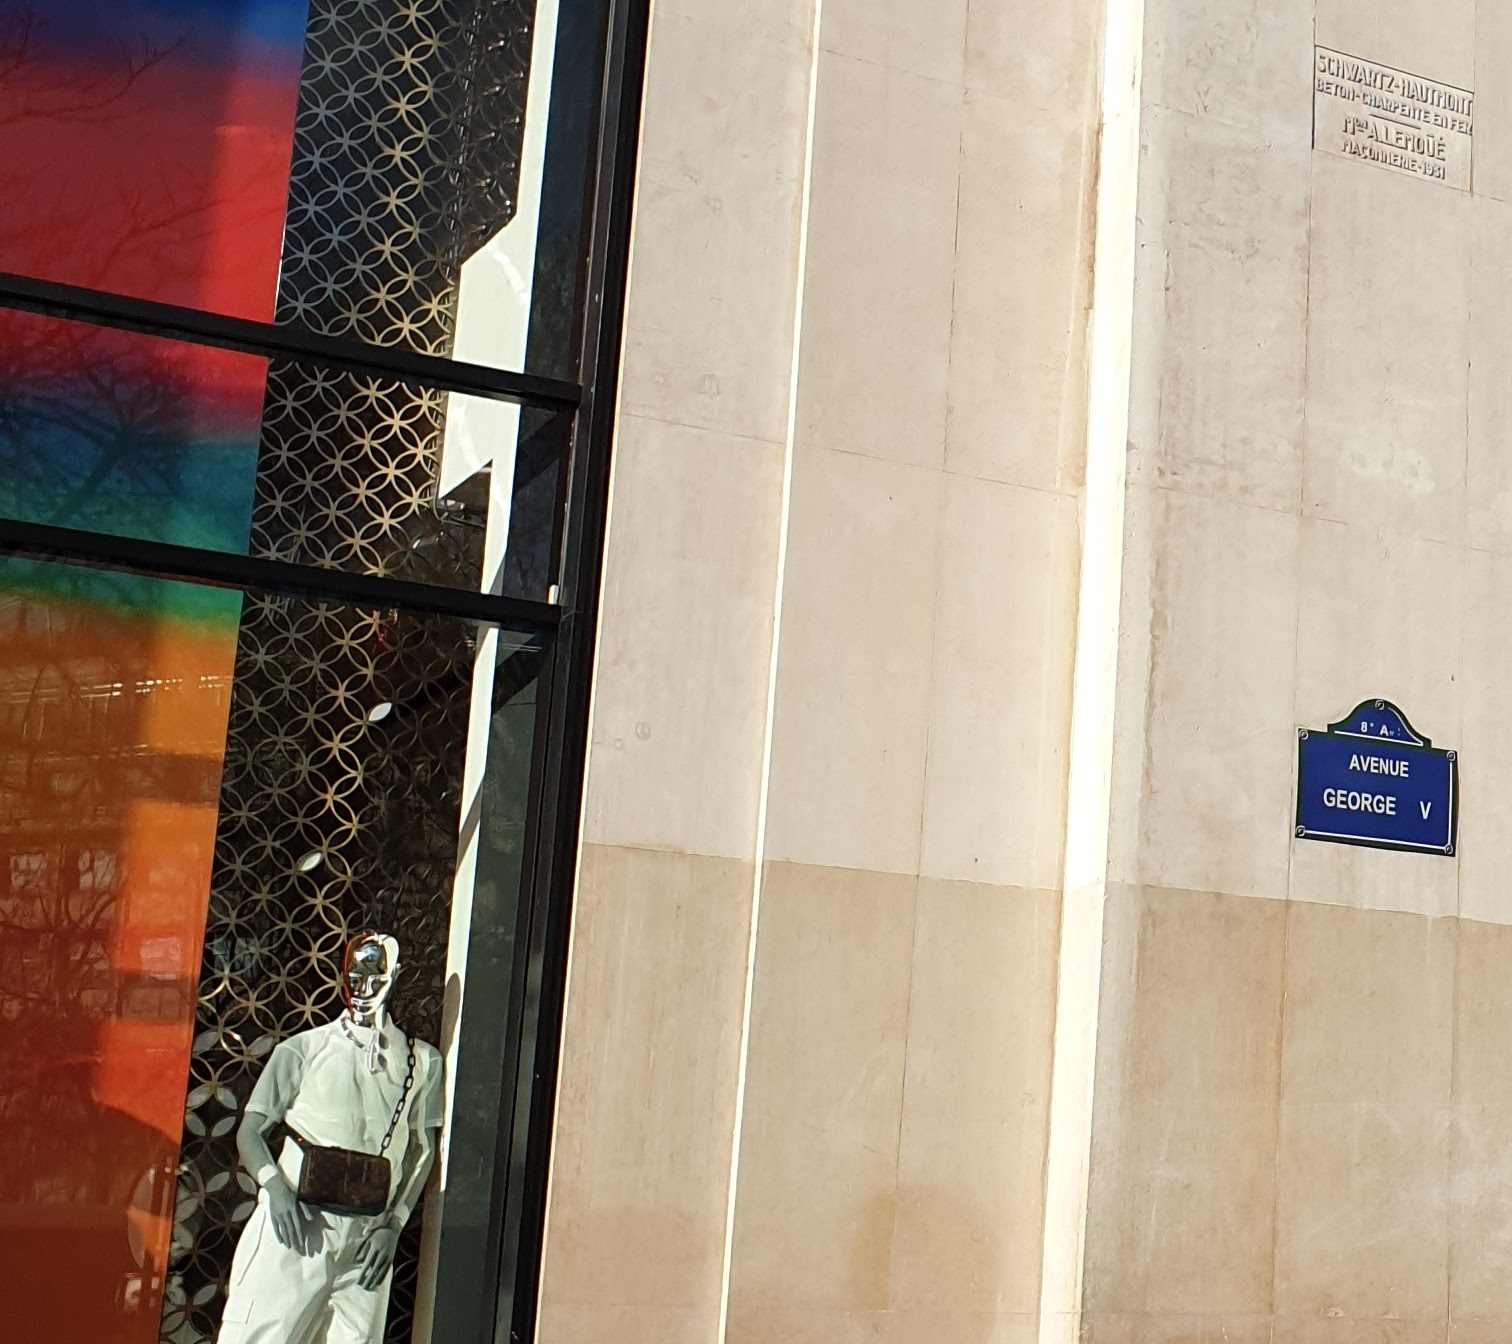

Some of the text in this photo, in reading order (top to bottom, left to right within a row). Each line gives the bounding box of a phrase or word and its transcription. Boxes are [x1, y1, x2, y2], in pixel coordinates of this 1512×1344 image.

[1349, 754, 1410, 777] AVENUE
[1323, 788, 1432, 820] GEORGE V
